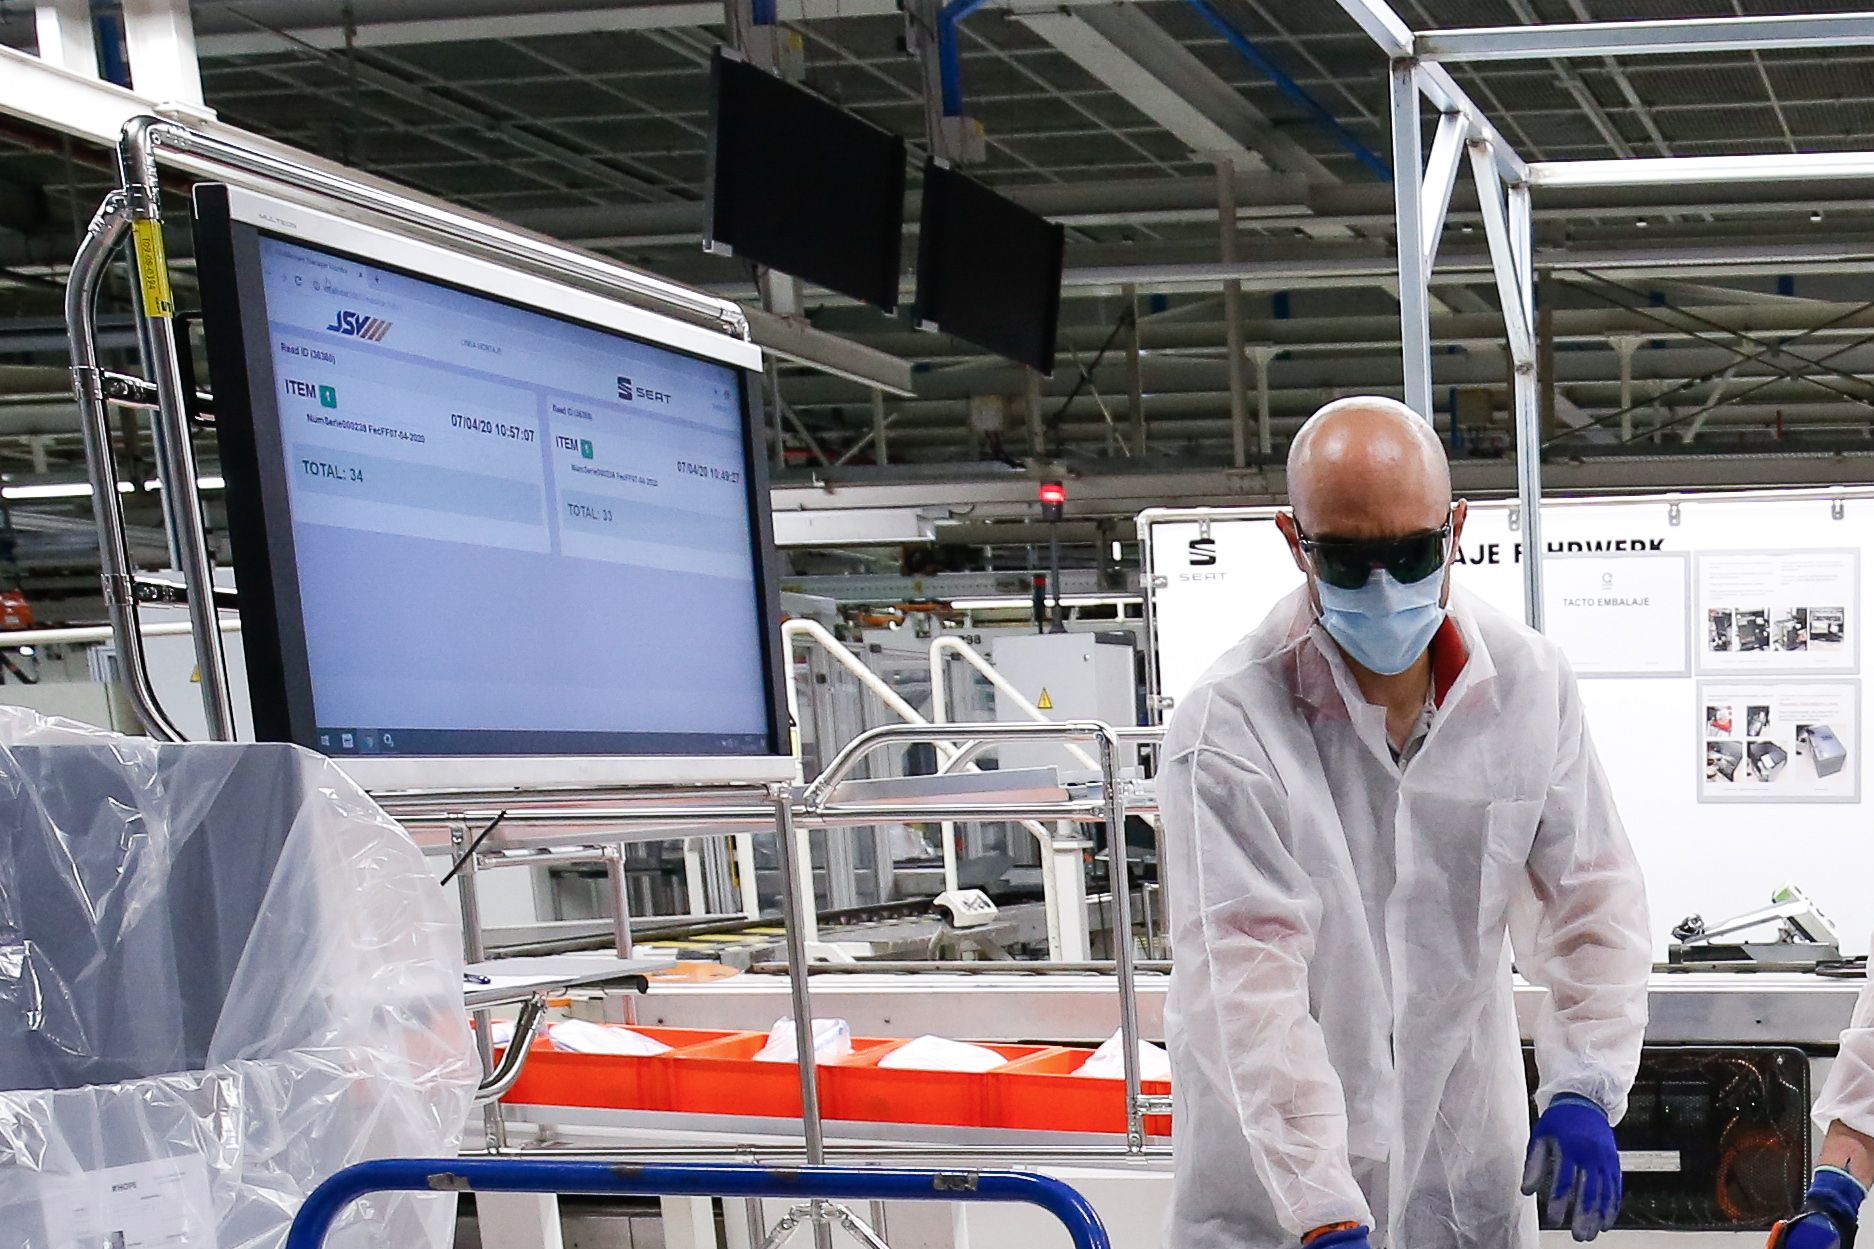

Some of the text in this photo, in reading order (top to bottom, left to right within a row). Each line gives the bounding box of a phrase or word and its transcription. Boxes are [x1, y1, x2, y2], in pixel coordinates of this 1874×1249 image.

[326, 310, 371, 338] JSV
[285, 379, 317, 399] ITEM
[636, 387, 672, 404] SEAT
[451, 414, 534, 443] 07/04/20 10:57:07
[556, 436, 579, 452] ITEM
[302, 459, 364, 484] TOTAL: 34
[567, 503, 600, 521] TOTAL:
[1179, 572, 1228, 582] SEAT
[1563, 596, 1650, 607] TACTO EMBALAJE
